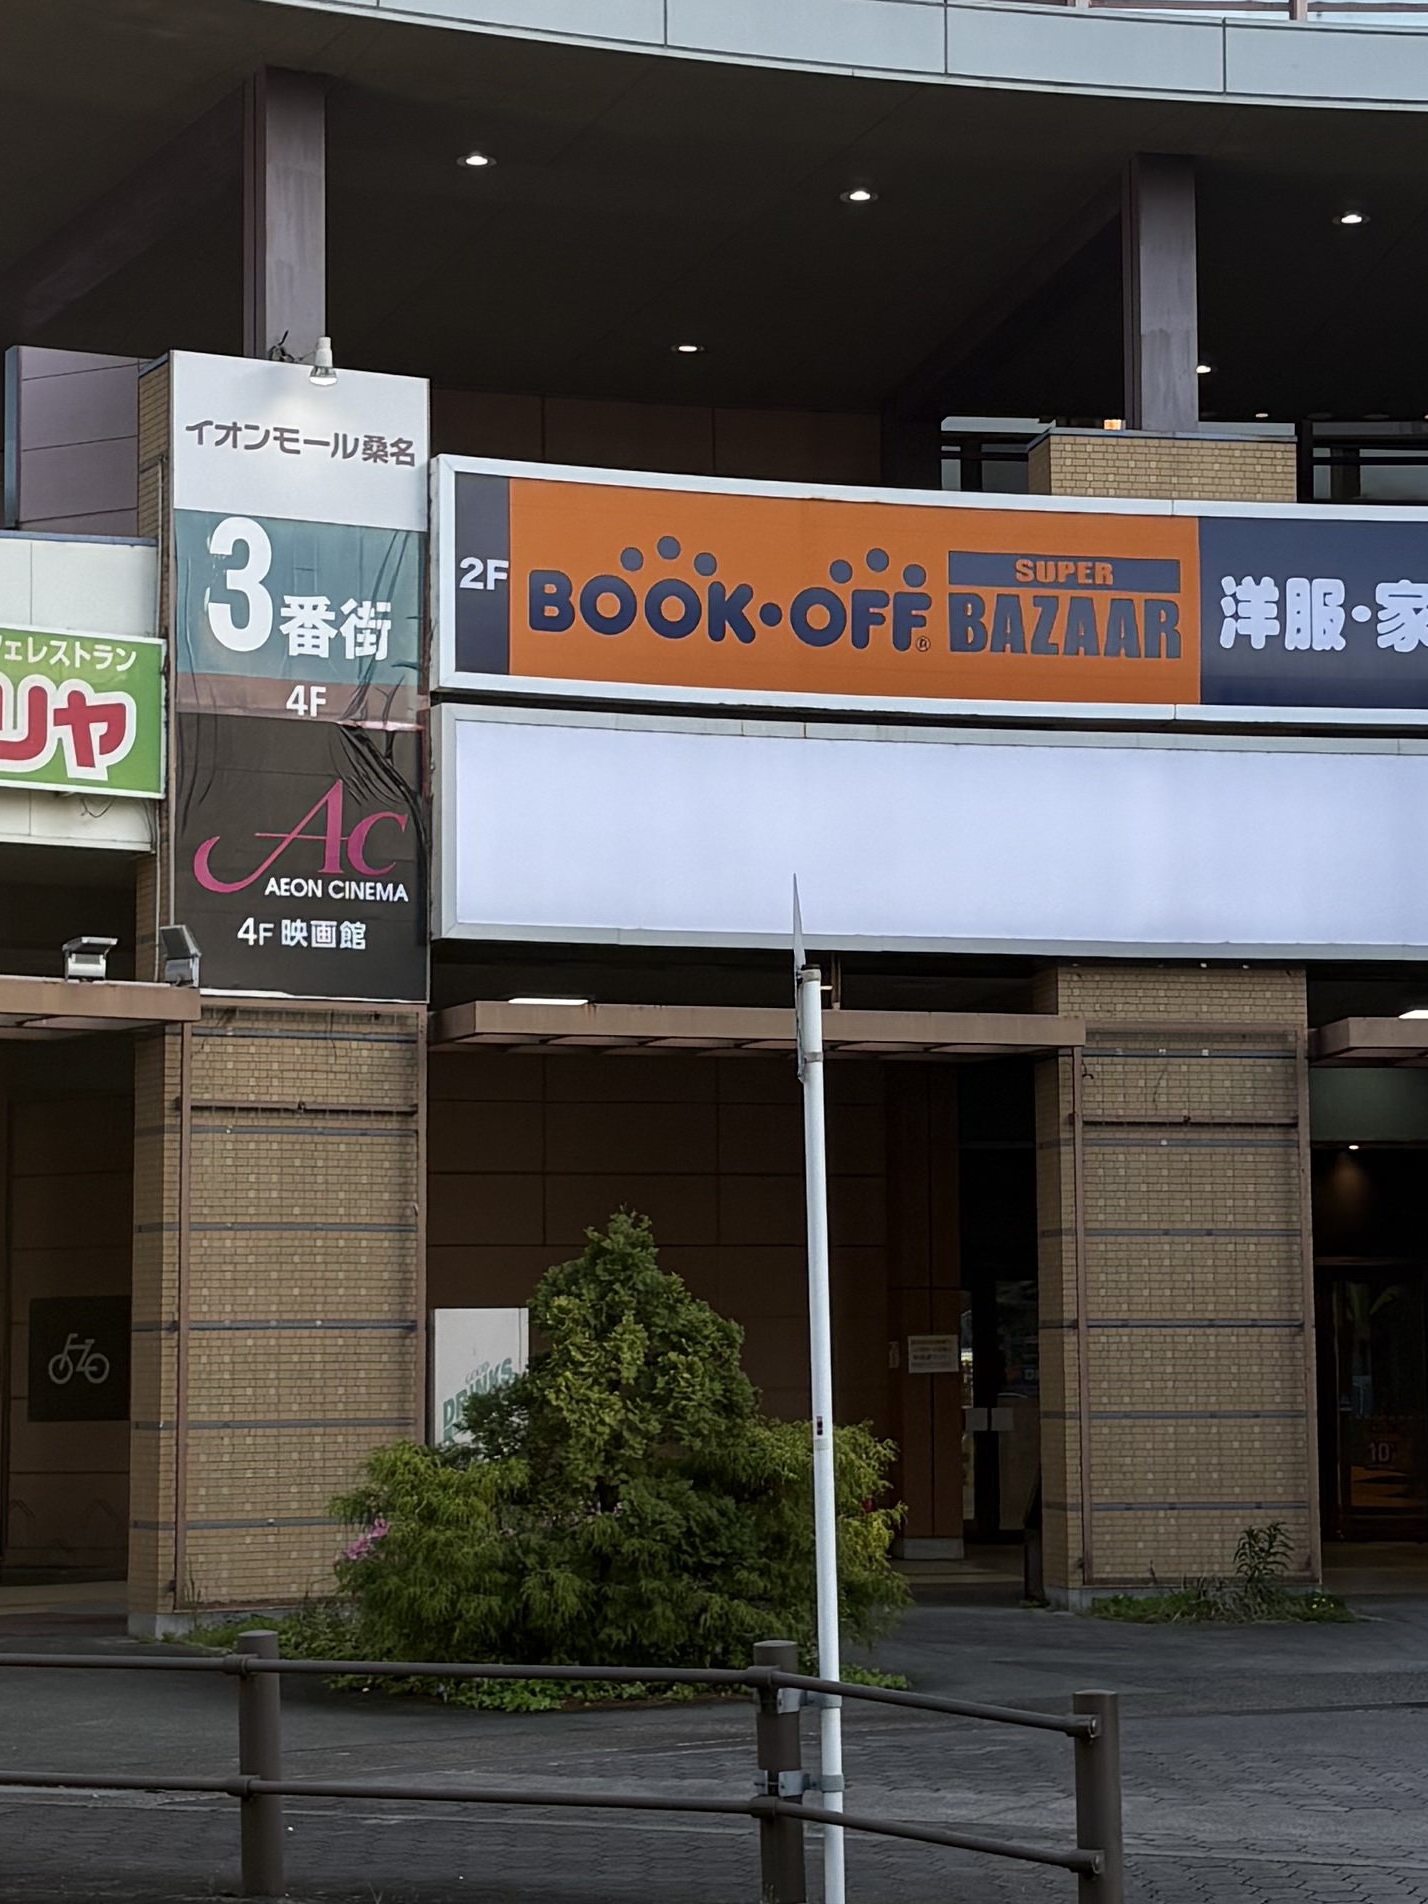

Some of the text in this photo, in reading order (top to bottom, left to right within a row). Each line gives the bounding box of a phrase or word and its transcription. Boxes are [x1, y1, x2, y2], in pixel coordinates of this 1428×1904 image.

[186, 418, 416, 467] イオンモール桑名
[459, 556, 509, 591] 2F
[1015, 558, 1114, 585] SUPER
[948, 592, 1182, 659] BAZAAR
[286, 684, 327, 717] 4F
[264, 877, 409, 902] AEON CINEMA
[237, 918, 367, 951] 4F 映画館
